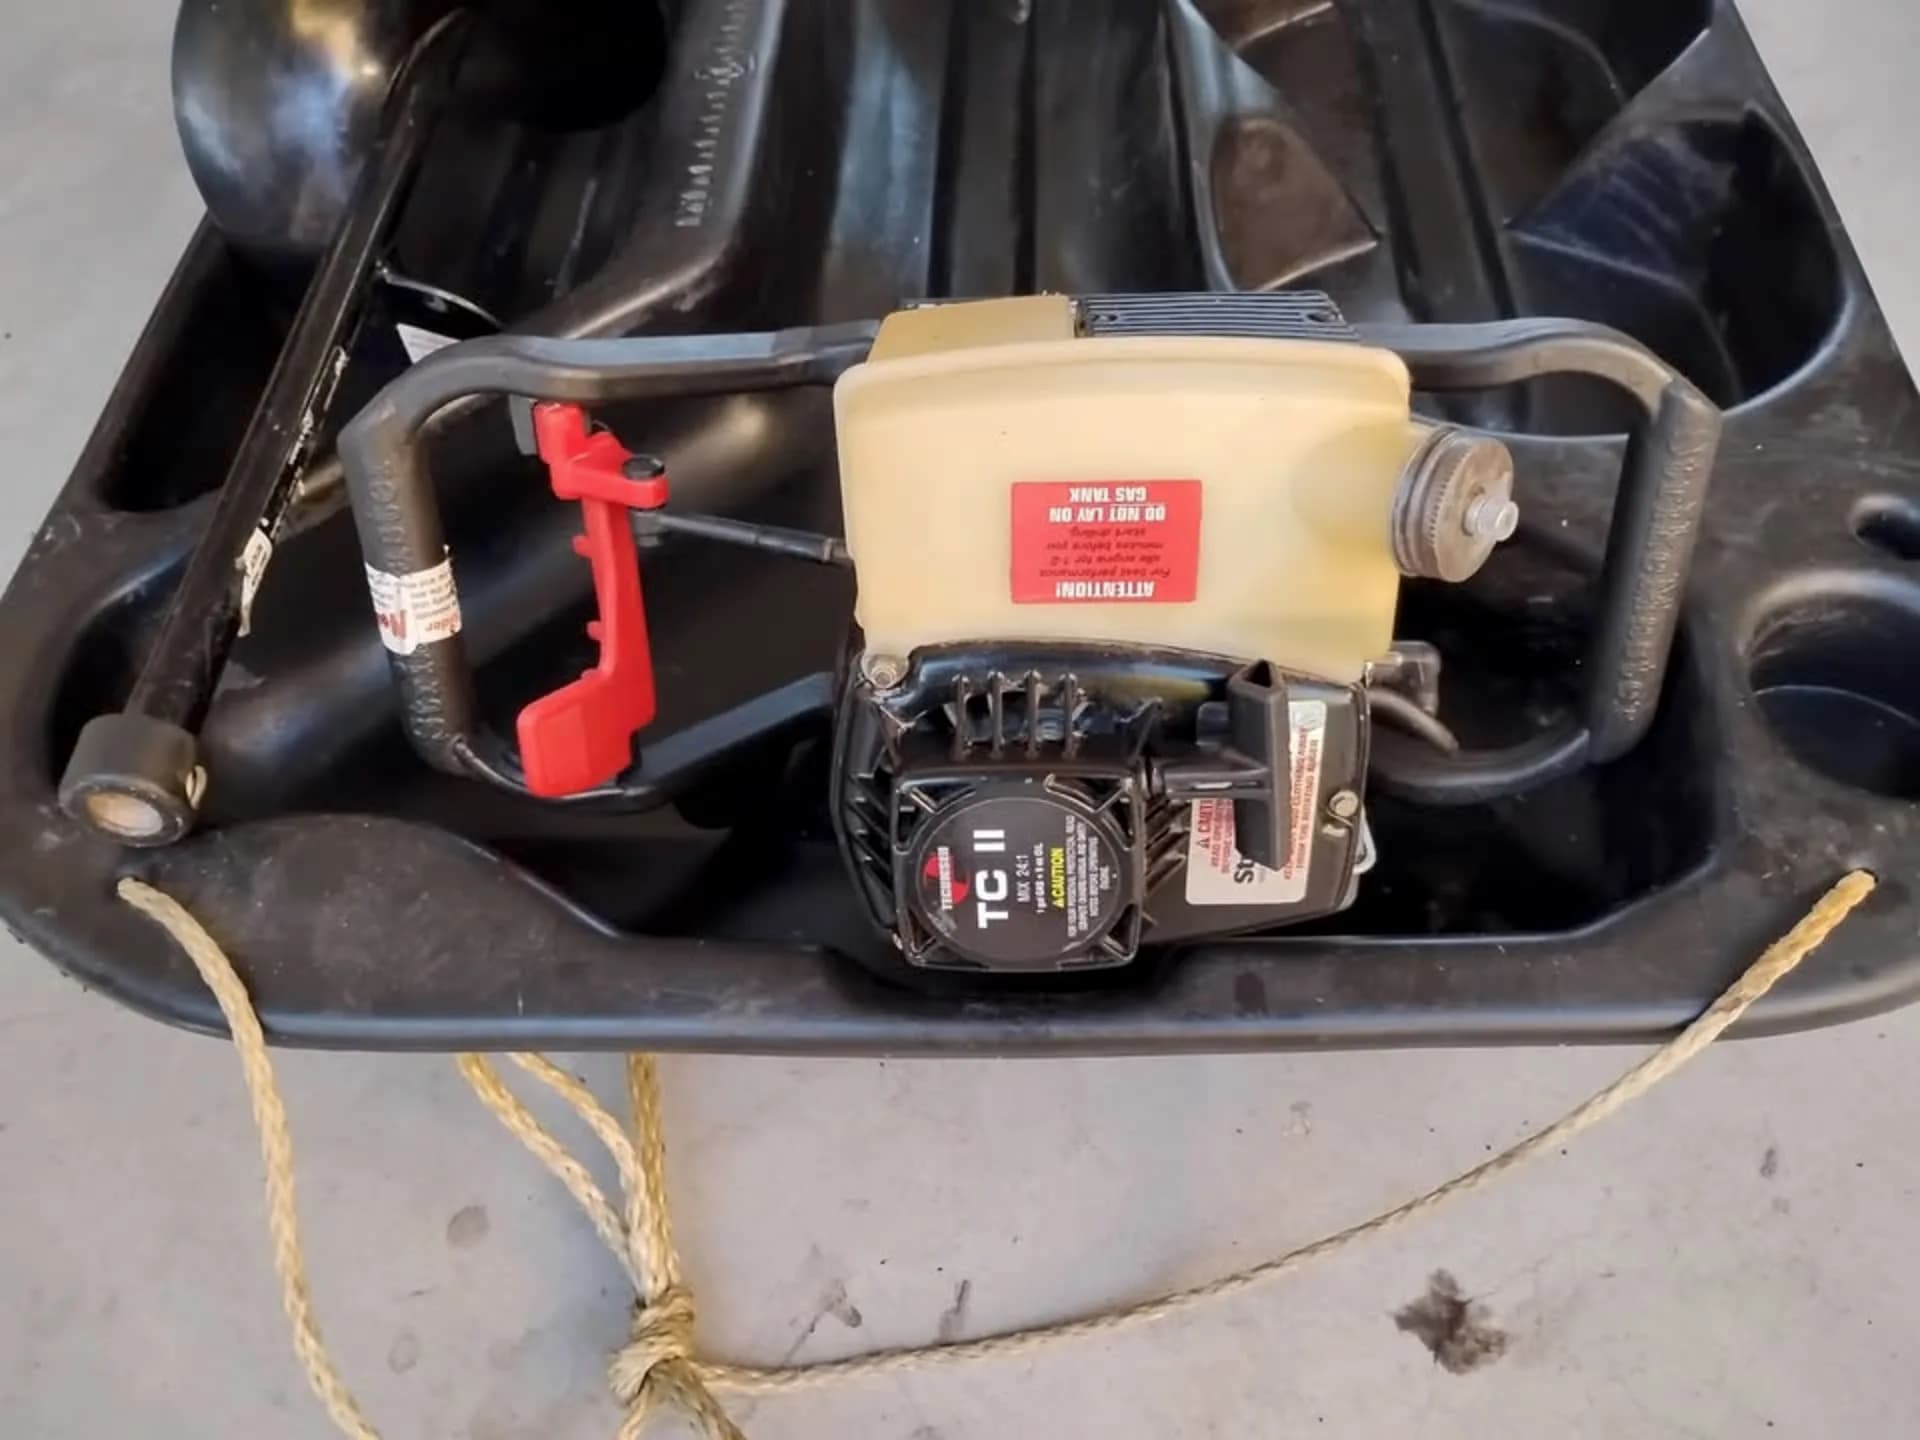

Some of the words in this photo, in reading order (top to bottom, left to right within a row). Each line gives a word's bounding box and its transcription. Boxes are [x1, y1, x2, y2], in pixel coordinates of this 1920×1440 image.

[1069, 487, 1109, 502] TANK
[1115, 487, 1146, 501] GAS
[1049, 508, 1072, 522] ON
[1076, 507, 1103, 522] LAY
[1110, 507, 1139, 521] NOT
[1144, 506, 1165, 520] DO
[1115, 529, 1146, 537] start
[1048, 541, 1068, 551] you
[1072, 542, 1111, 552] before
[1116, 541, 1163, 551] minutes
[1075, 555, 1092, 565] for
[1098, 553, 1135, 563] engine
[1040, 567, 1117, 579] performance
[1056, 581, 1154, 598] ATTENTION!
[1199, 800, 1213, 833] CAUTI
[974, 829, 1005, 852] II
[1016, 855, 1030, 877] 24:1
[1052, 848, 1064, 897] CAUTION
[975, 870, 1008, 928] TC
[1017, 882, 1031, 902] MIX
